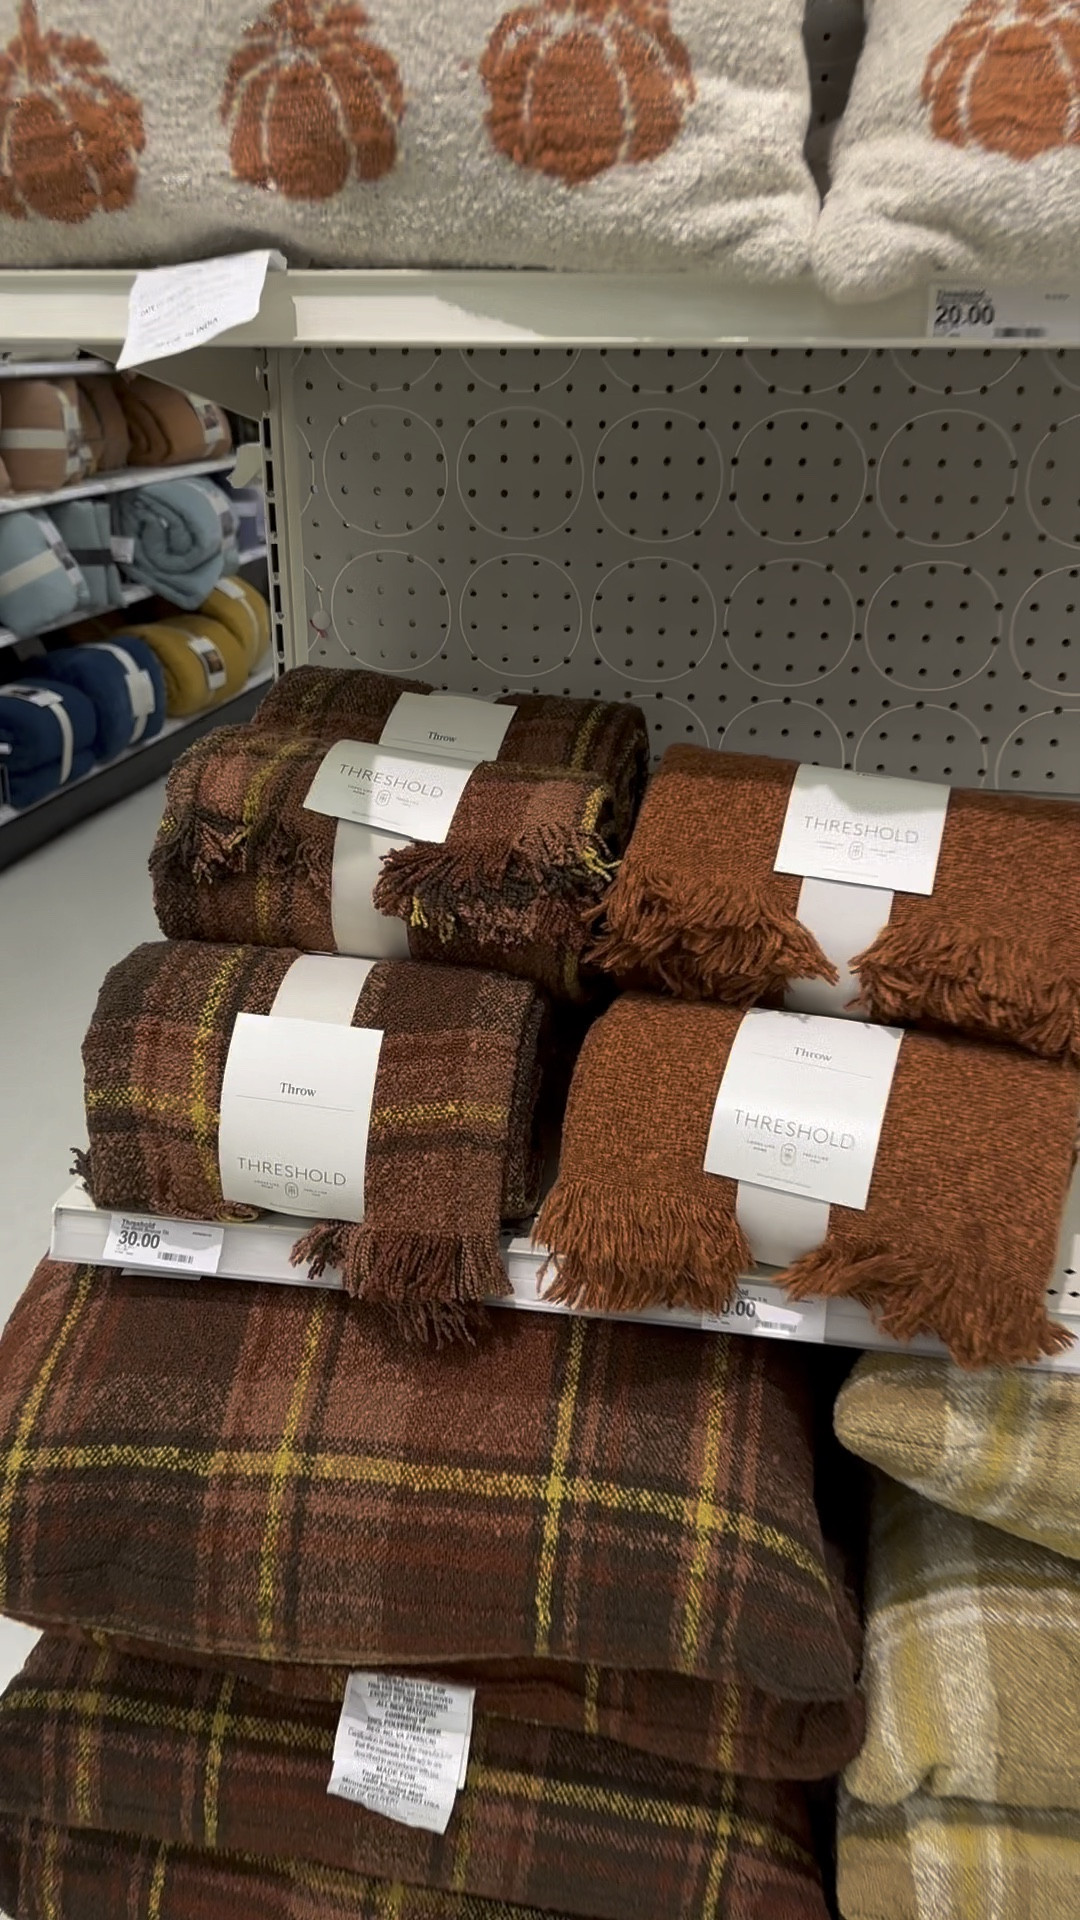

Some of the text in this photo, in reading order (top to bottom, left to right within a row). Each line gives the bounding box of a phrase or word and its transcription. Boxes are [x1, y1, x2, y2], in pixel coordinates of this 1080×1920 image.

[935, 305, 995, 325] 20.00
[428, 731, 457, 743] Throw
[340, 763, 443, 799] THRESHOLD
[804, 815, 919, 844] THRESHOLD
[794, 1046, 833, 1062] Throw
[280, 1081, 317, 1097] Throw
[735, 1109, 855, 1150] THRESHOLD
[238, 1157, 346, 1186] THRESHOLD
[122, 1219, 156, 1229] Threshold
[119, 1230, 160, 1249] 30.00
[721, 1299, 756, 1317] 0.00
